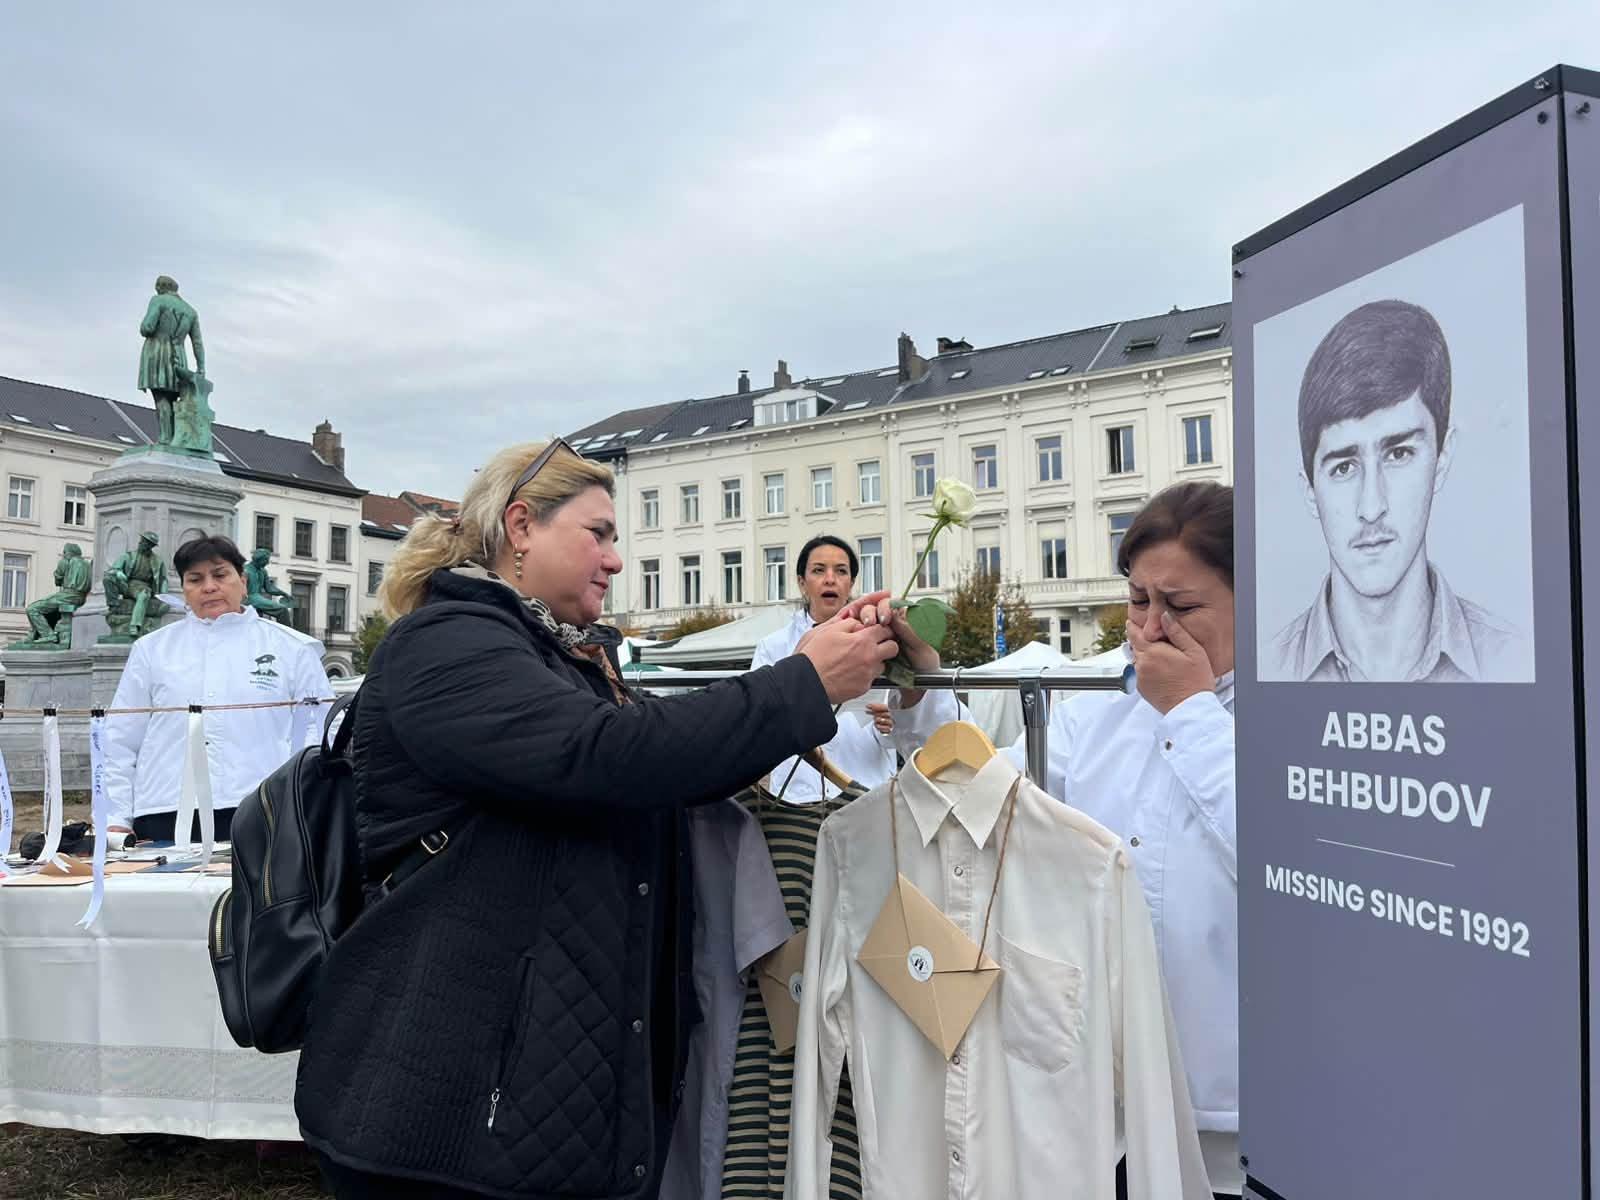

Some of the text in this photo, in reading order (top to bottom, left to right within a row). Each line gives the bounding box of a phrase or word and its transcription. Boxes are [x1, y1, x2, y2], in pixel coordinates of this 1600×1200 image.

[1321, 711, 1446, 756] ABBAS
[1287, 765, 1492, 828] BEHBUDOV
[1265, 863, 1531, 958] MISSING SINCE 1992
